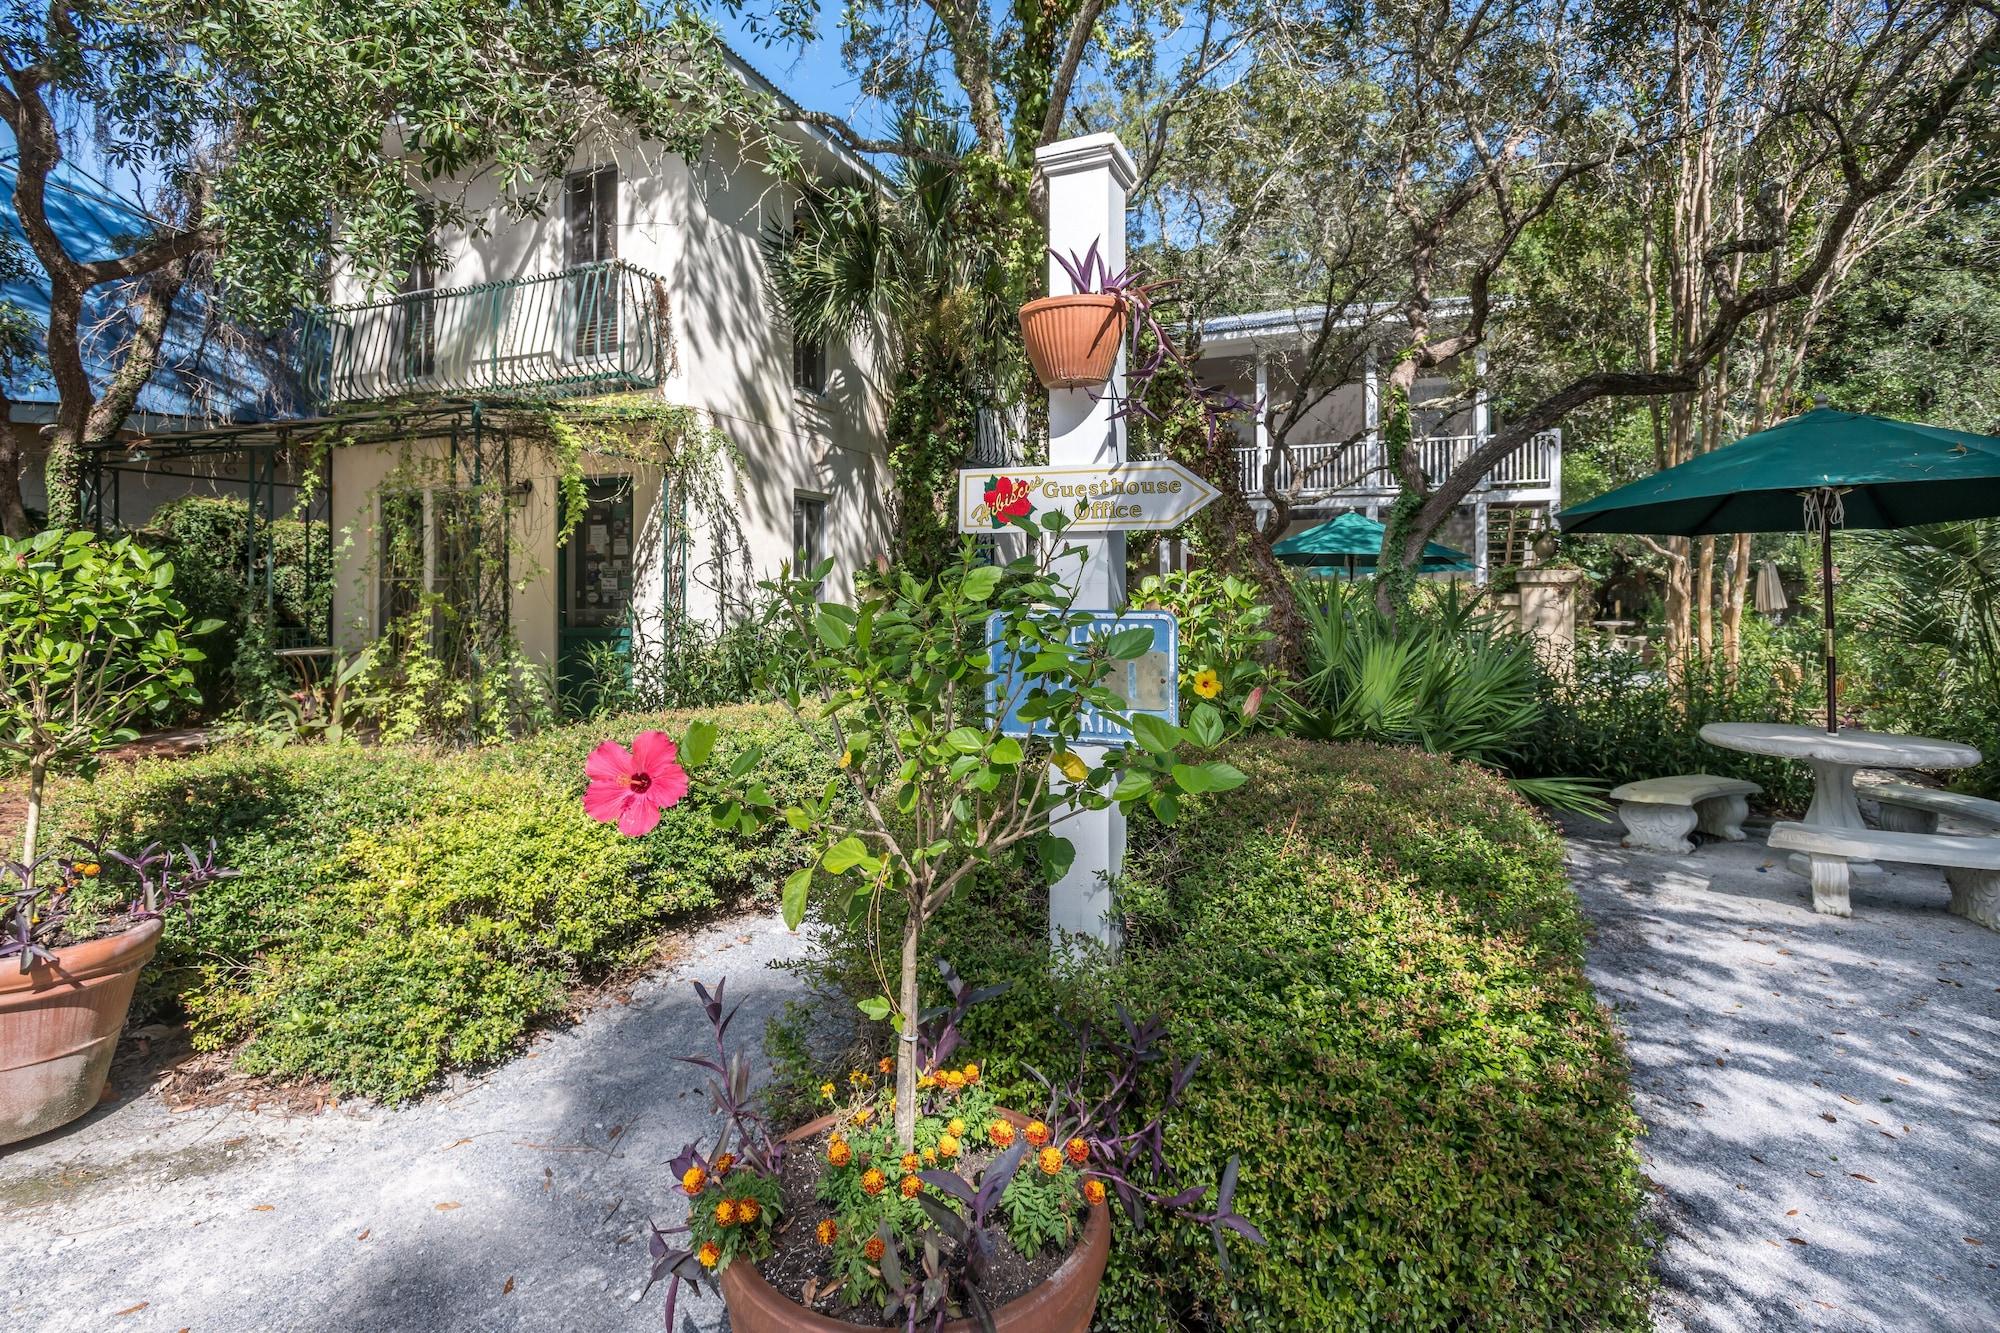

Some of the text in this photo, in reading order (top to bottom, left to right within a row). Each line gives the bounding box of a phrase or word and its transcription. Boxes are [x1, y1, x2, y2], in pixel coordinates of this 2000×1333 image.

[1042, 478, 1182, 498] Guesthouse
[971, 475, 1044, 526] Hibiscus
[1074, 501, 1143, 520] Office
